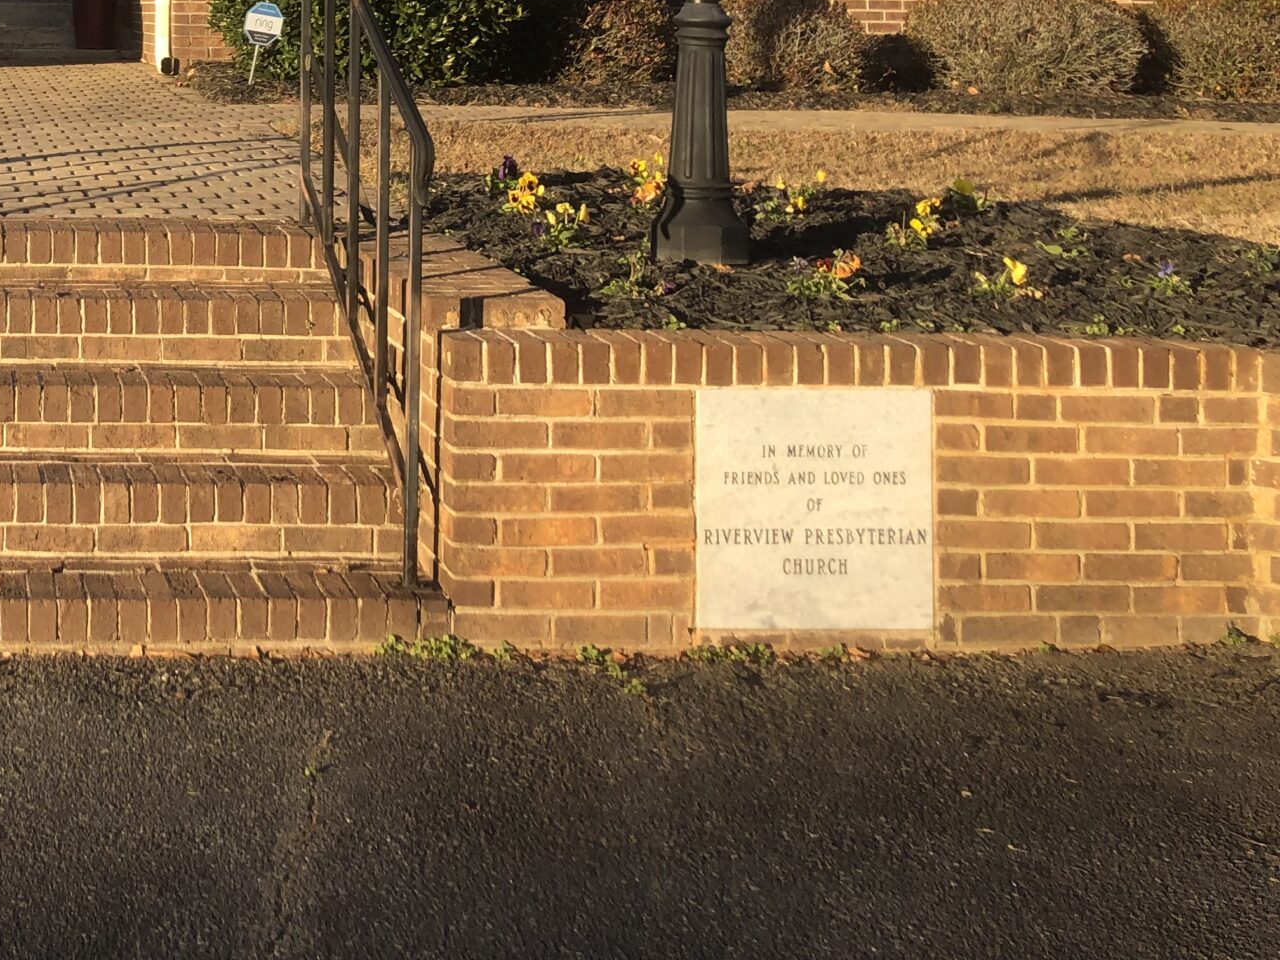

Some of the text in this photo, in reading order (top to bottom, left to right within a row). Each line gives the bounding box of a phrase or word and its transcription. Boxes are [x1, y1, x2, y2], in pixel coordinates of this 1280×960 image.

[255, 17, 273, 31] ring
[762, 444, 868, 458] IN MEMORY OF
[724, 472, 906, 485] FRIENDS AND LOVED ONES
[807, 498, 822, 511] OF
[704, 529, 928, 545] RIVERVIEW PRESBYTERIAN
[783, 559, 848, 575] CHURCH
